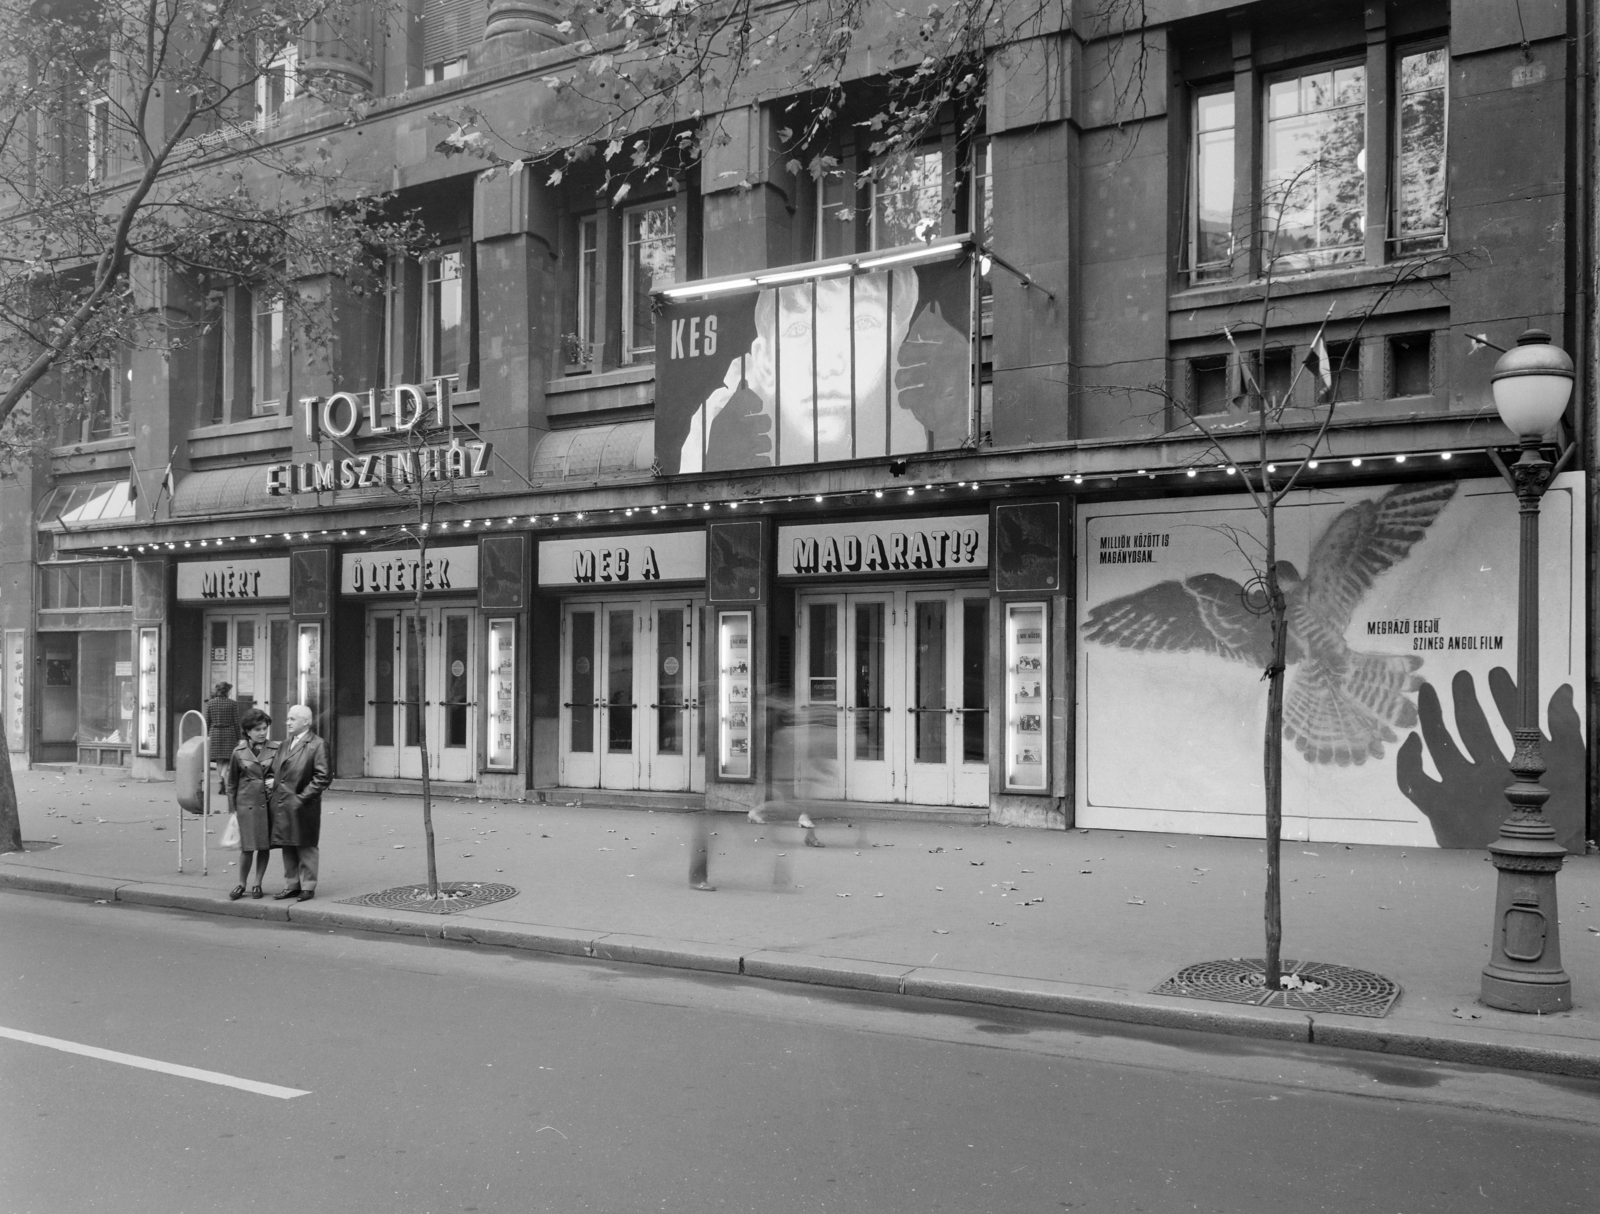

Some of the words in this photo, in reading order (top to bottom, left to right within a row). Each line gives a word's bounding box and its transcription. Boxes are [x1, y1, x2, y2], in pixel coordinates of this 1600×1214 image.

[671, 315, 717, 359] KES
[299, 378, 450, 442] TOLDI
[793, 529, 979, 573] MADARAT!?
[1134, 532, 1160, 548] KÖZÖTT
[1162, 534, 1170, 547] IS
[201, 566, 261, 598] MIÉRT
[573, 547, 630, 583] MEG
[641, 546, 660, 580] A
[1413, 636, 1444, 651] SZINES
[1448, 636, 1477, 650] ANGOL
[1480, 636, 1503, 650] FILM
